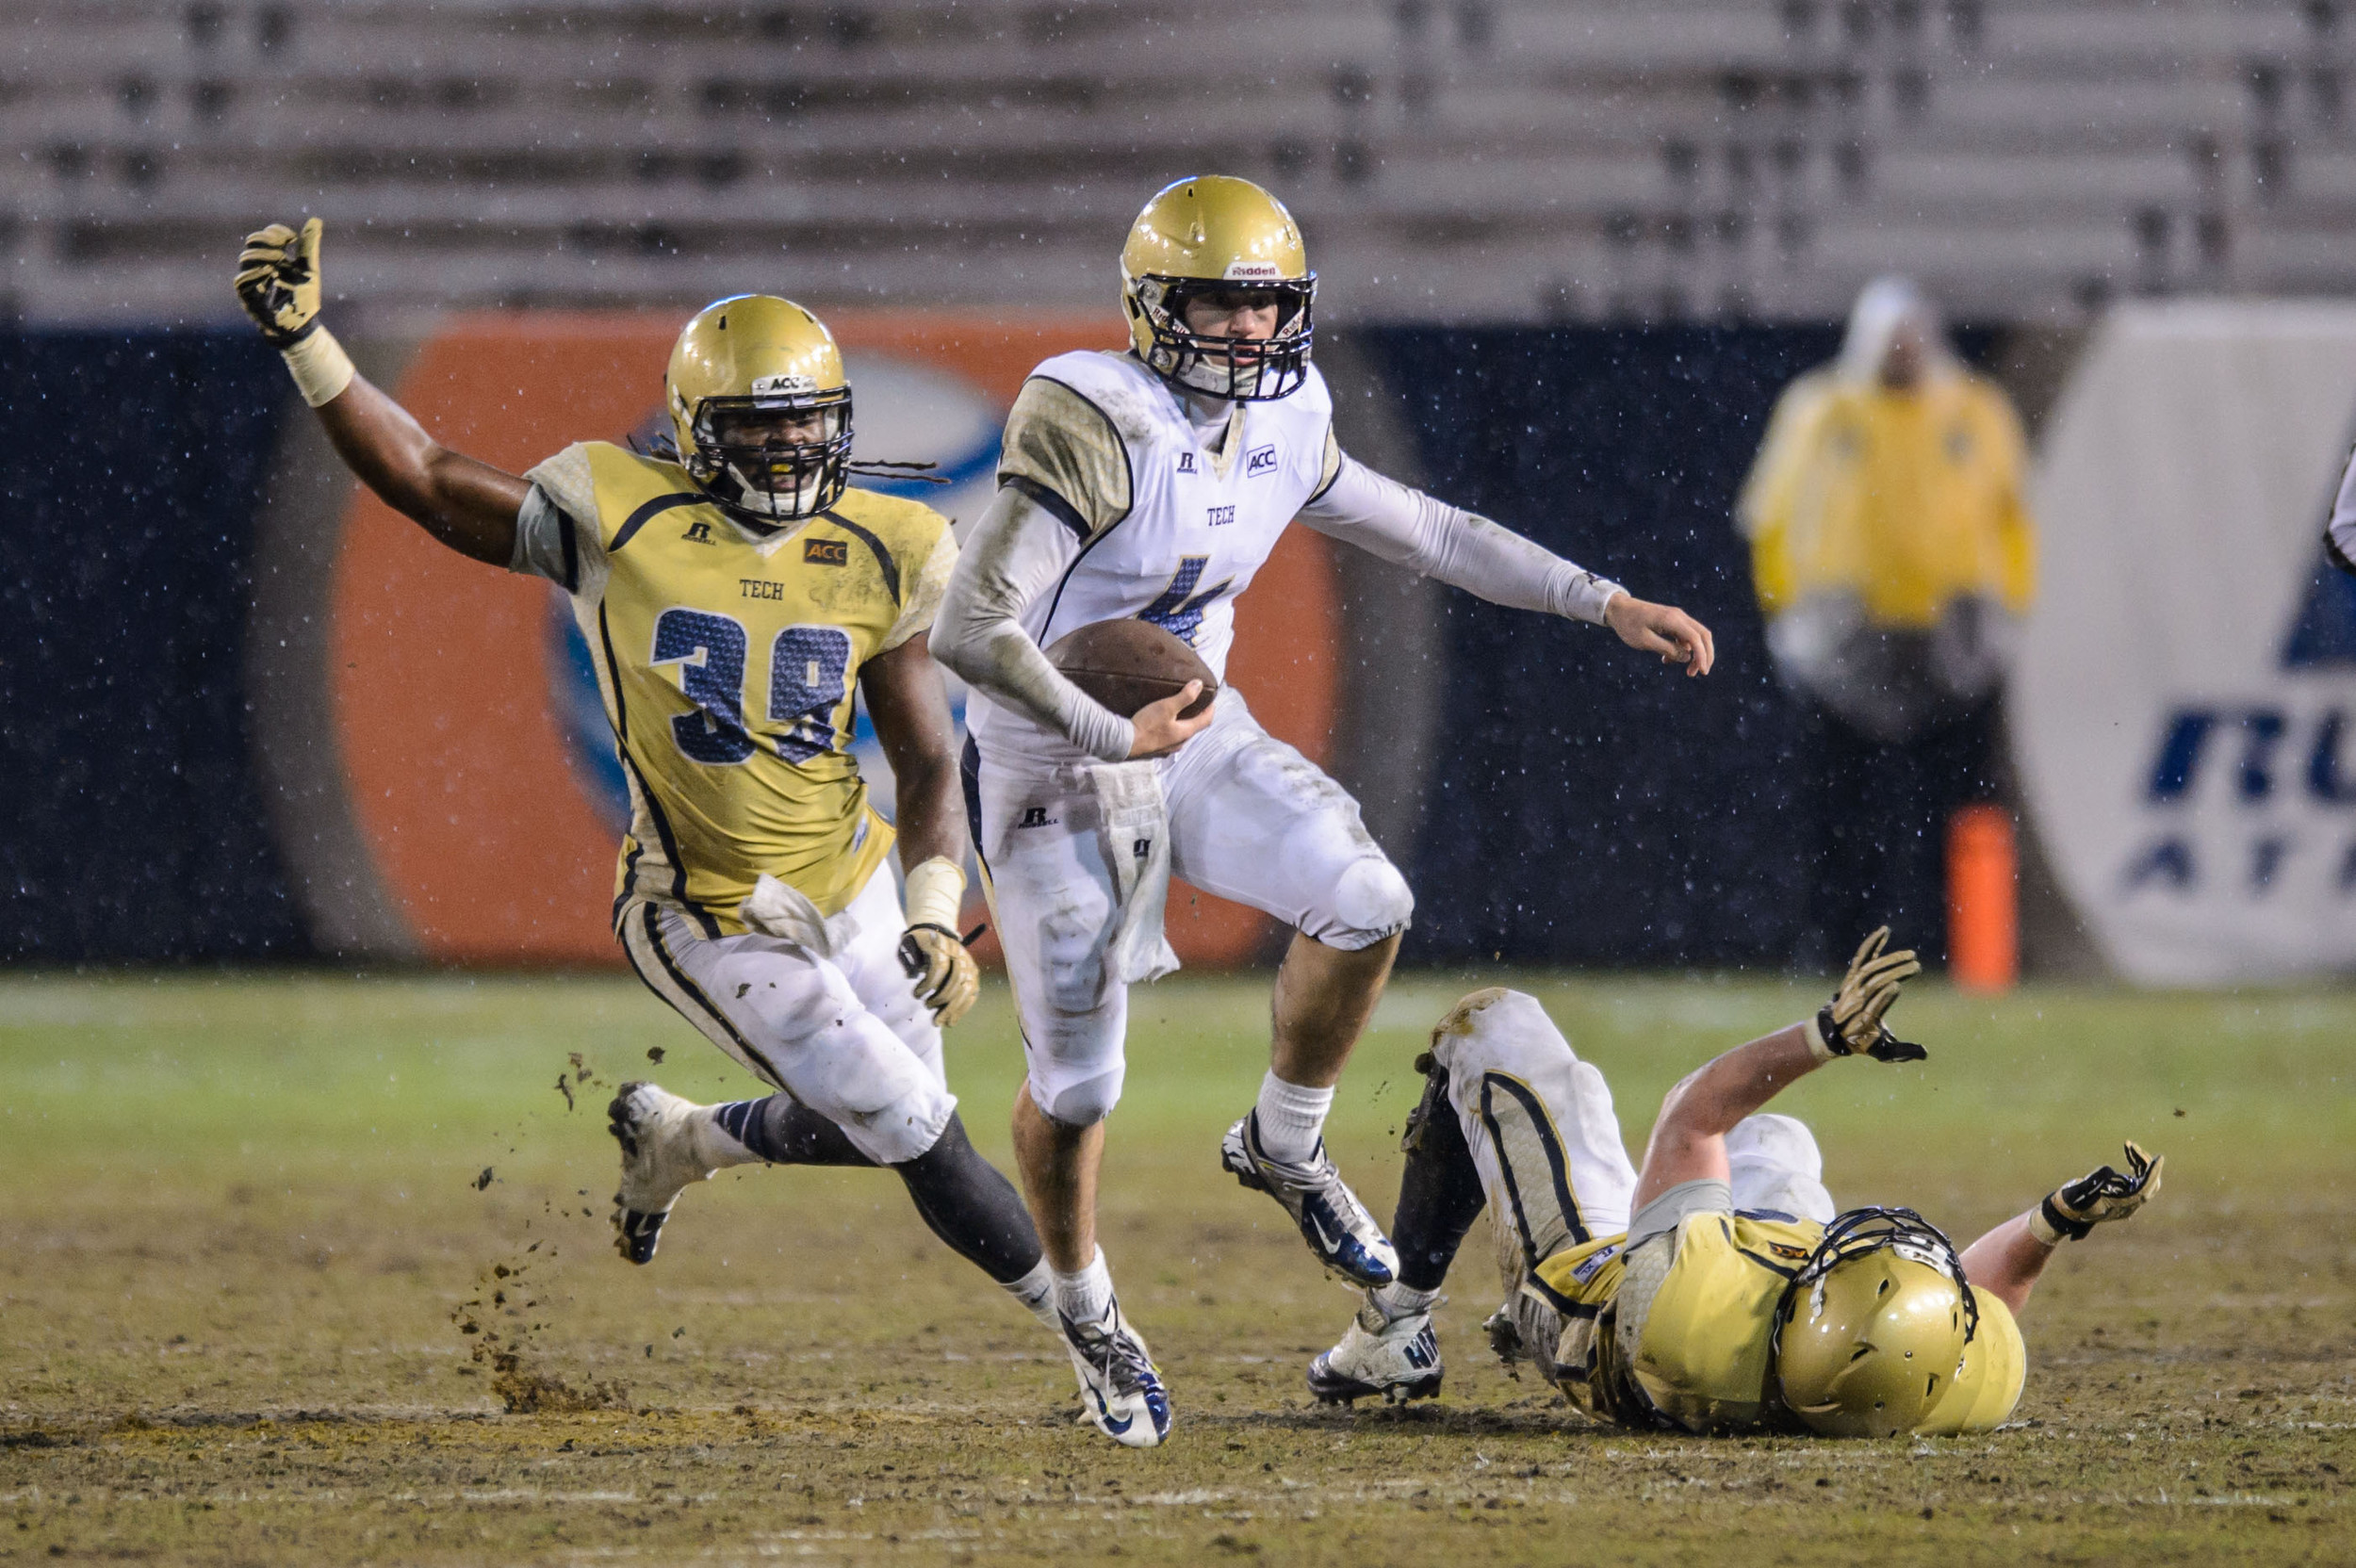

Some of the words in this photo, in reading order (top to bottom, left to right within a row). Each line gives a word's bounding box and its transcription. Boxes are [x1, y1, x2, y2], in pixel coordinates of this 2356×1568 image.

[1232, 266, 1276, 276] Riddell
[770, 377, 800, 391] ACC
[1249, 450, 1275, 472] ACC
[1207, 505, 1235, 527] TECH
[806, 544, 845, 562] ACC
[739, 579, 785, 601] TECH
